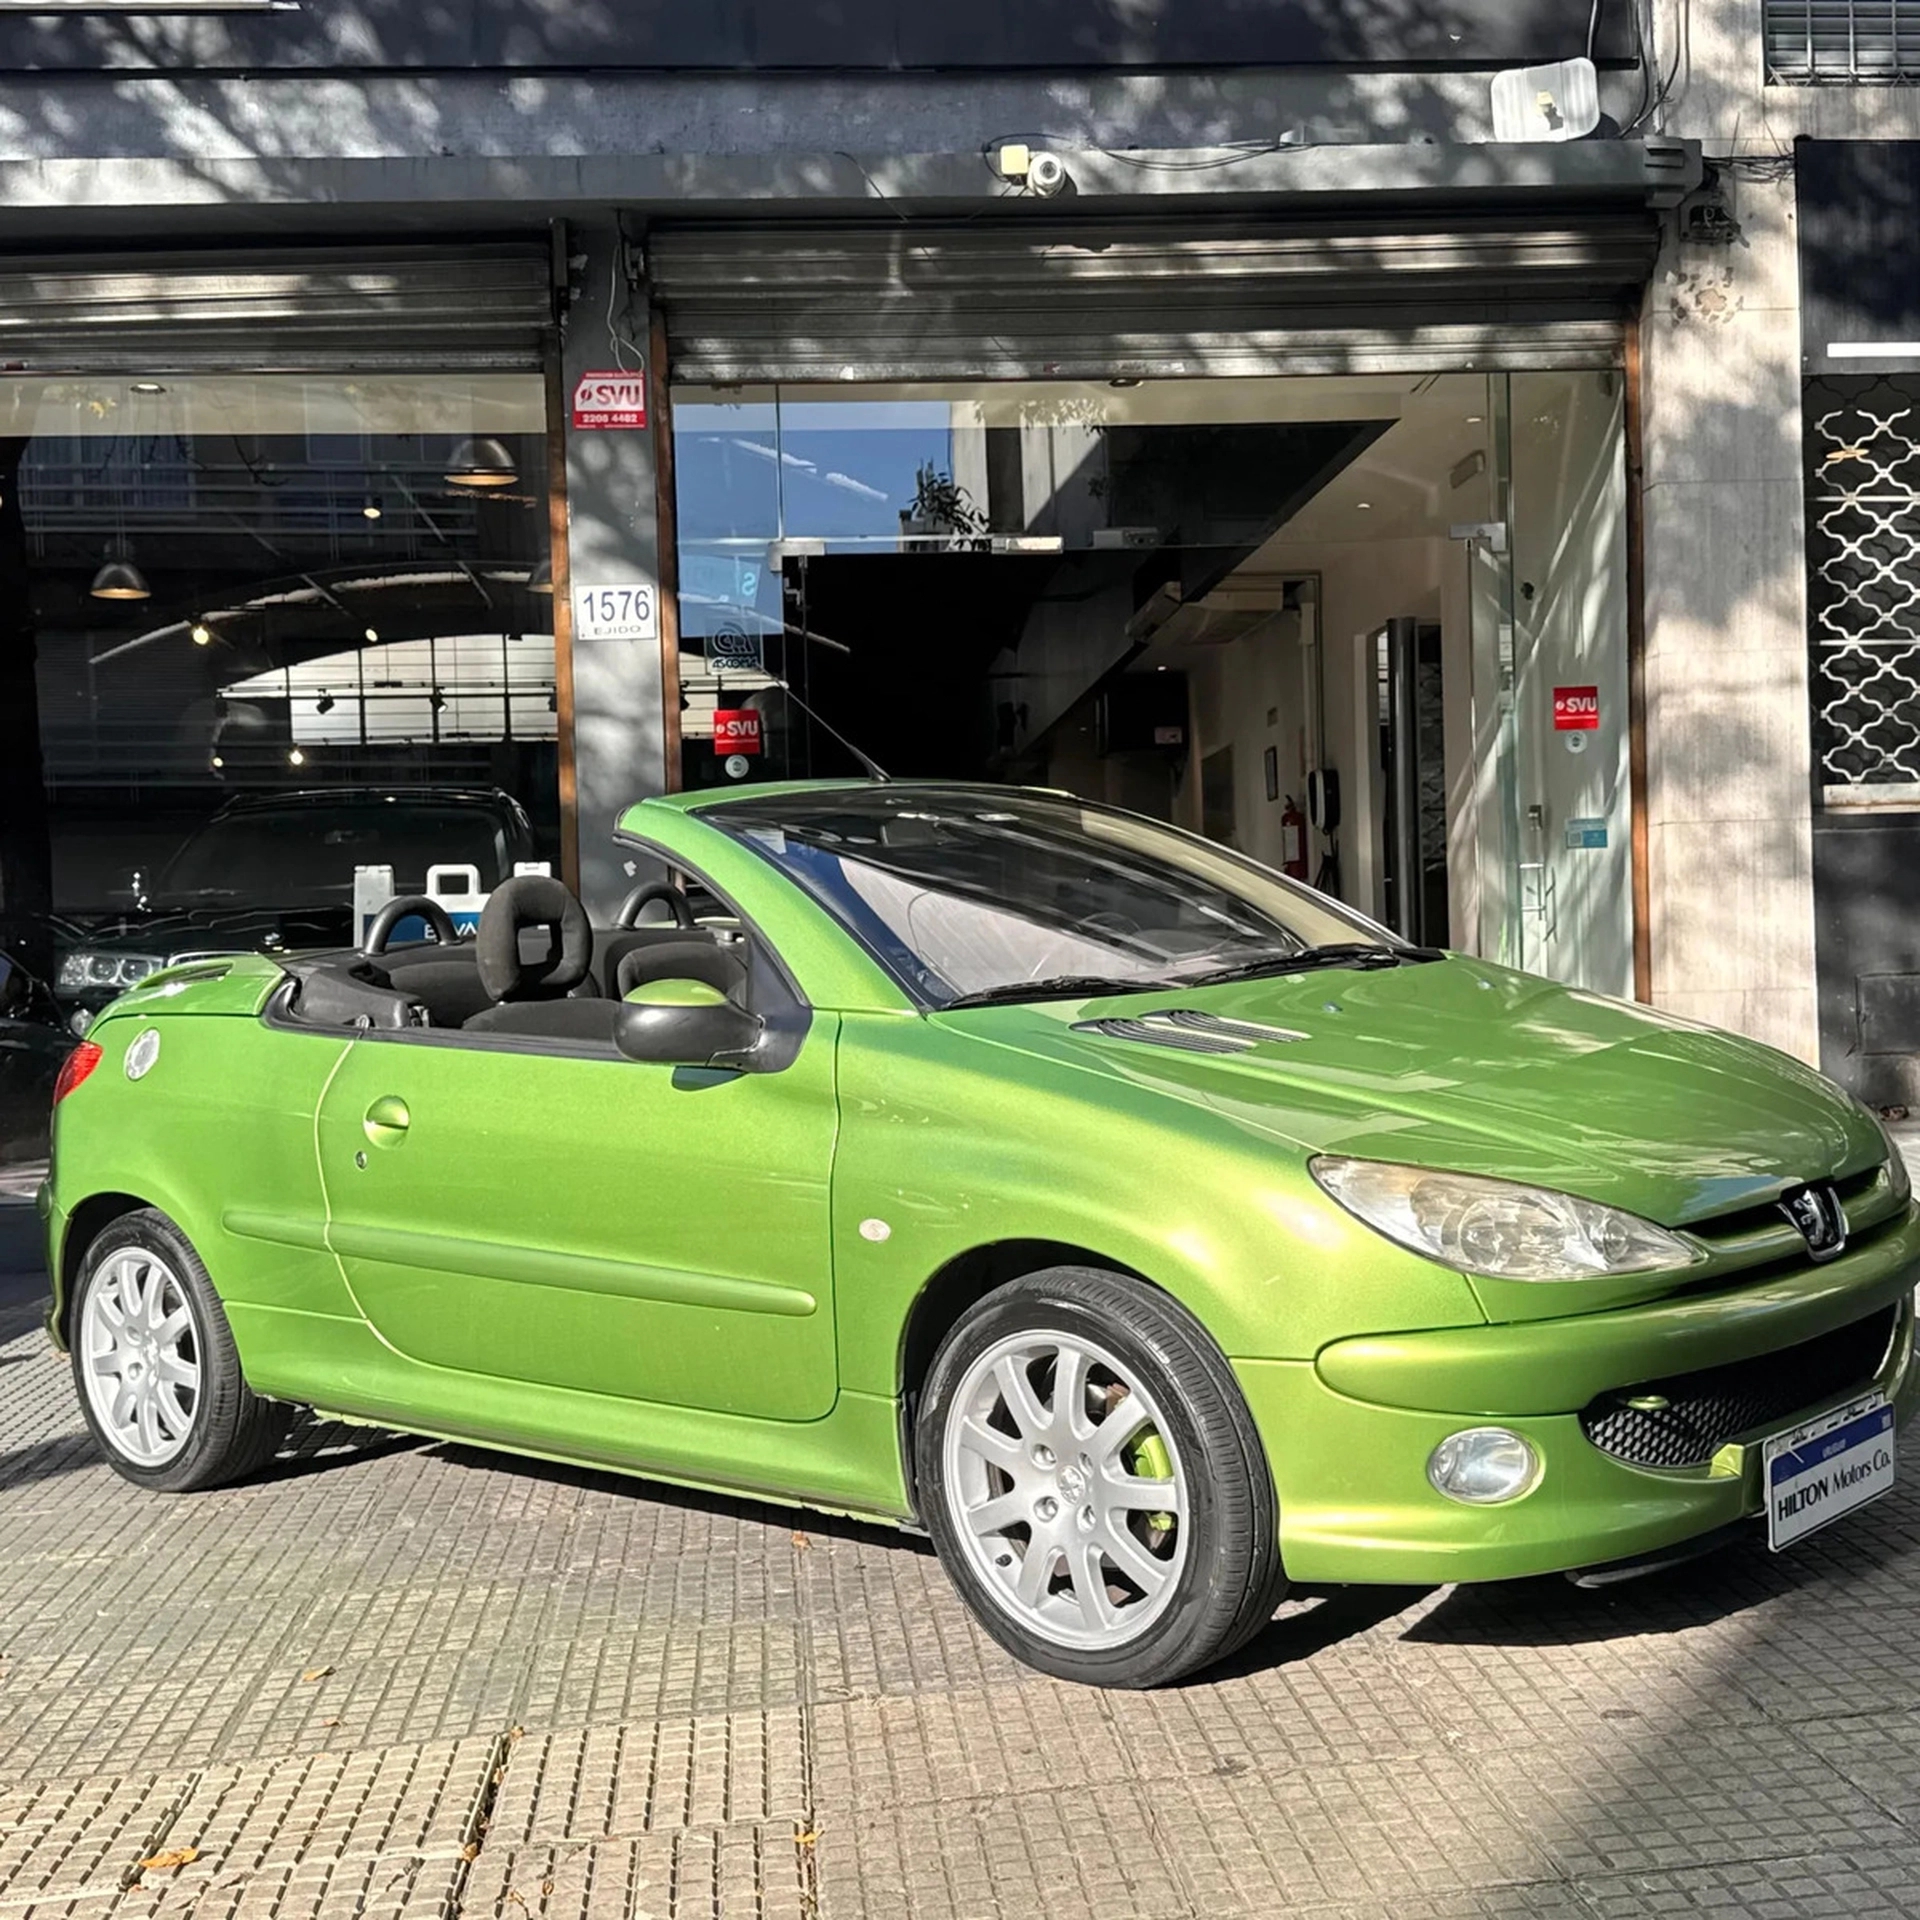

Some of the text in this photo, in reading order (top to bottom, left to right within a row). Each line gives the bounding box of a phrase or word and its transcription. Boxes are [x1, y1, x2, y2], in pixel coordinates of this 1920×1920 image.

[596, 385, 640, 405] SVU
[583, 590, 650, 622] 1576
[594, 625, 641, 635] EJIDO
[1566, 697, 1597, 713] SVU
[727, 720, 758, 736] SVU
[1778, 1449, 1891, 1521] HILTON Motors Co.
